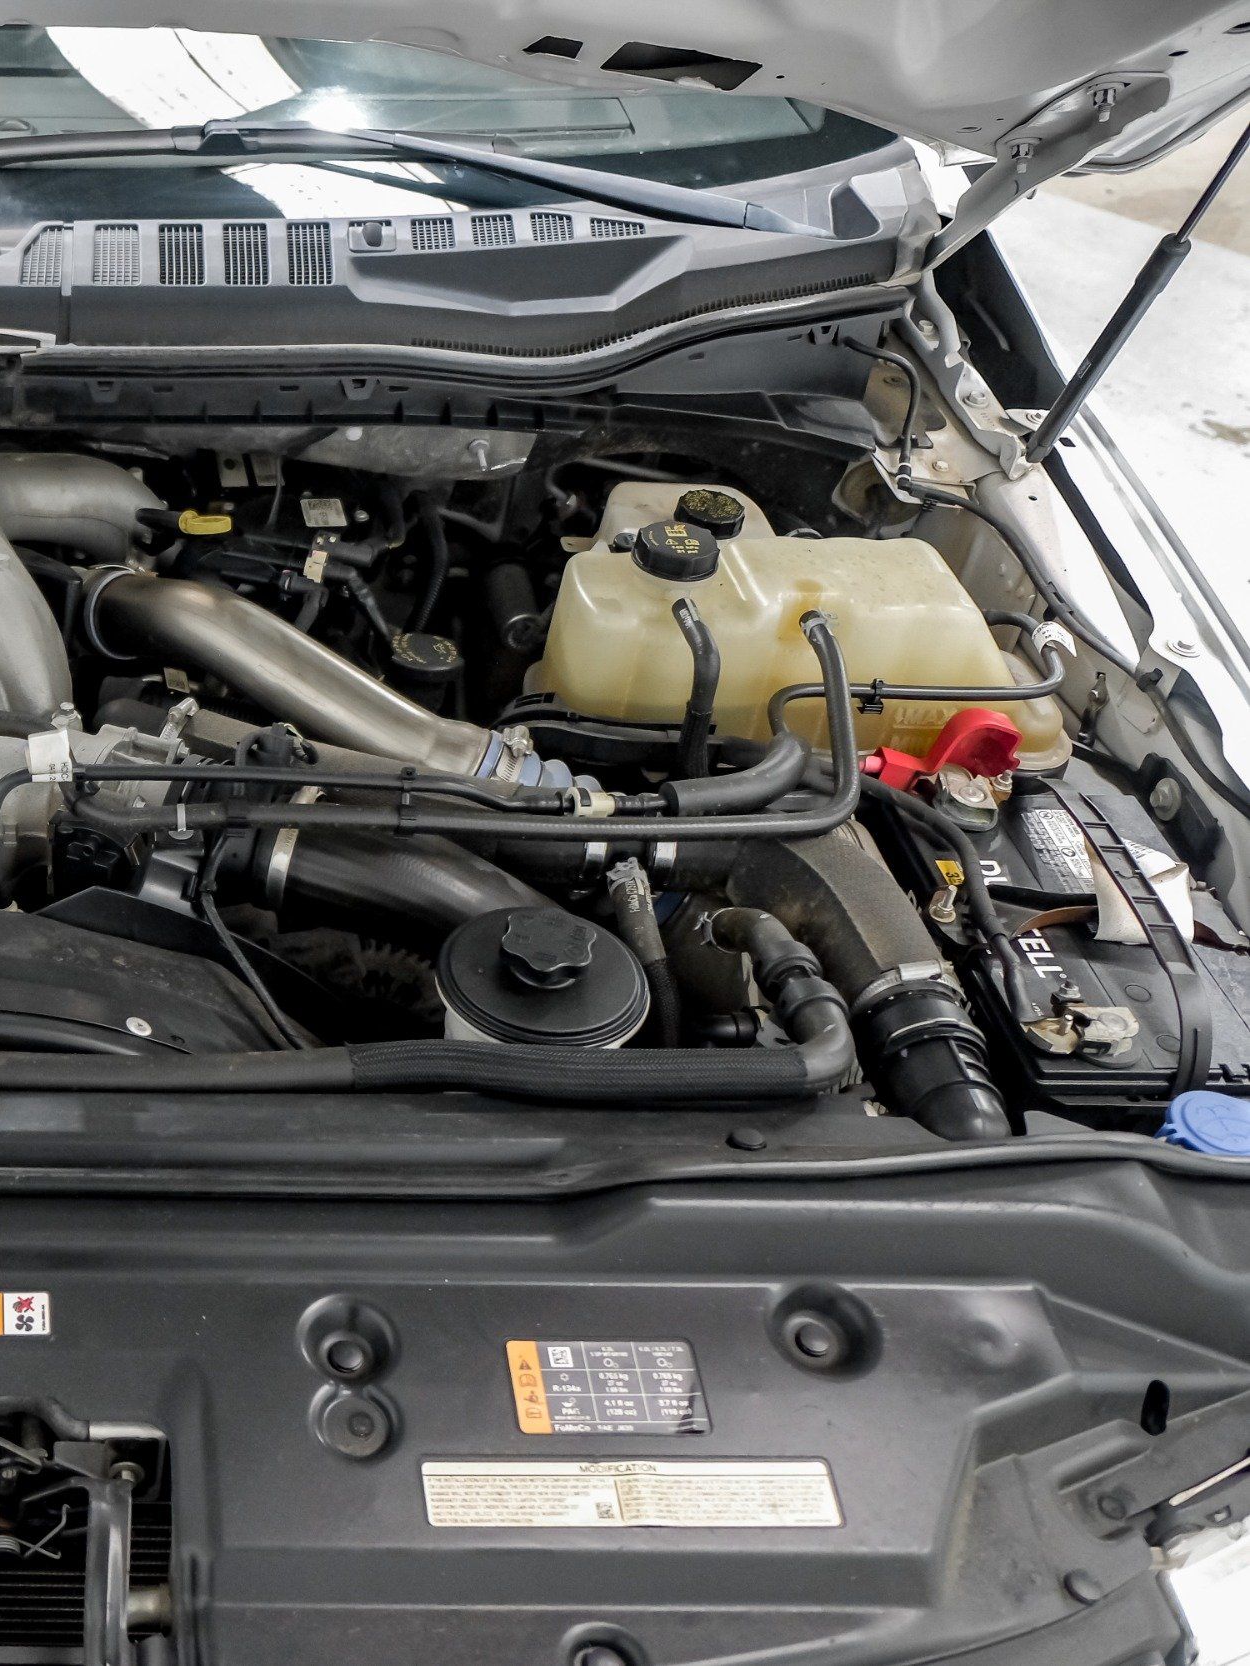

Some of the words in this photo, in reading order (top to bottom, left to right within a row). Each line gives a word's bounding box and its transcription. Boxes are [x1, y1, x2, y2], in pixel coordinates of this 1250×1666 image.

[552, 1384, 582, 1392] R-134a
[554, 1423, 591, 1432] FoMoCo
[579, 1463, 657, 1474] MODIFICATION
